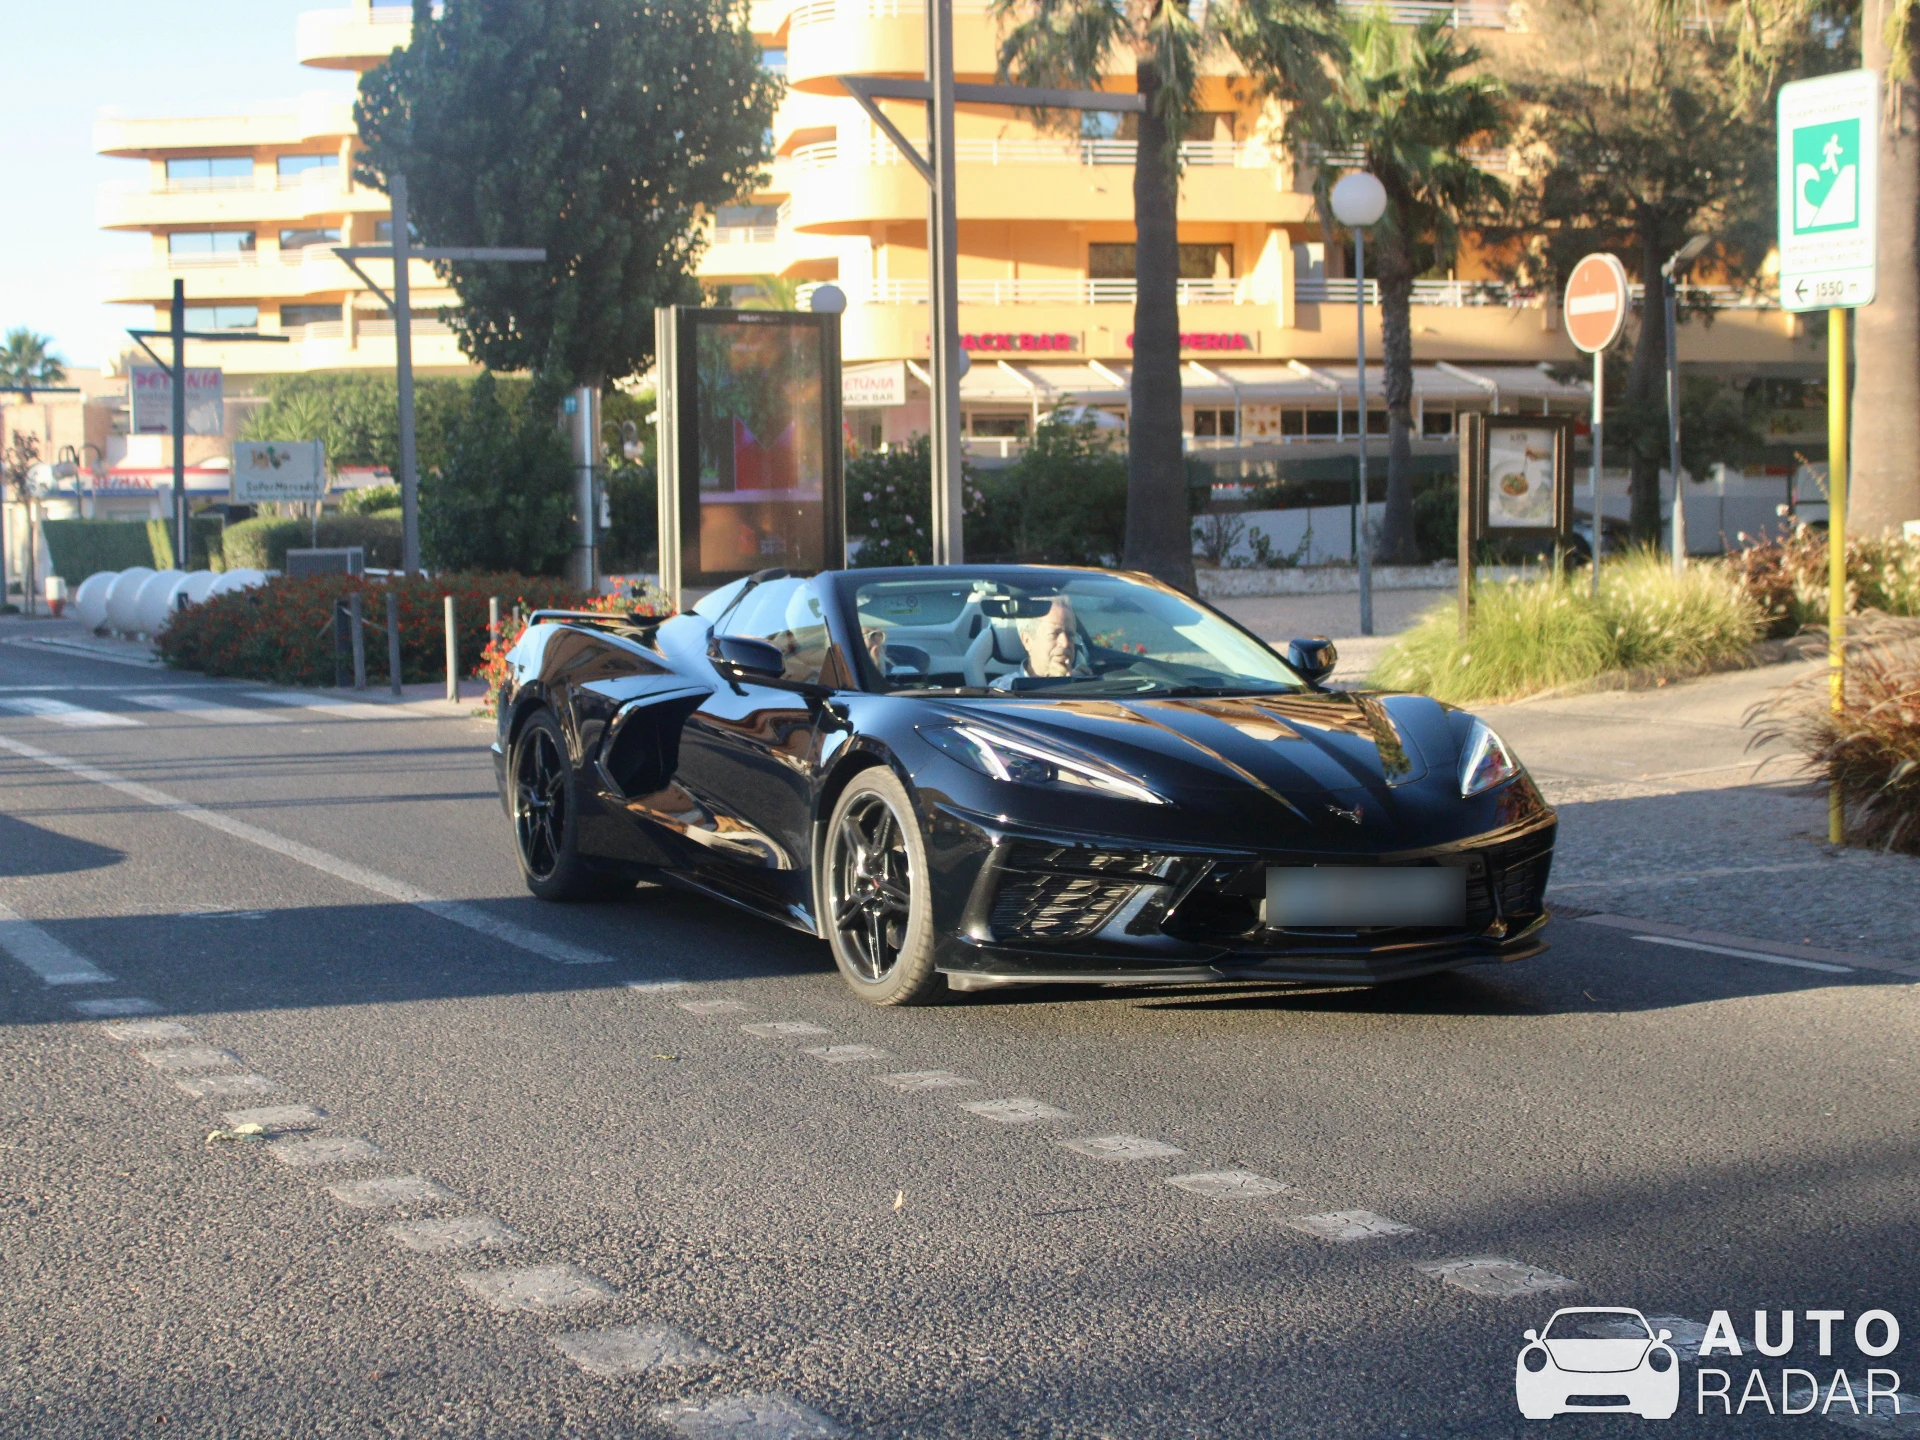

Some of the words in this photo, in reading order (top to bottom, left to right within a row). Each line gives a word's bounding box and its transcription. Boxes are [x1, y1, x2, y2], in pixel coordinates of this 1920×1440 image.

[1815, 280, 1844, 297] 1550
[1019, 333, 1071, 351] BAR
[135, 370, 219, 389] PETNIA
[843, 375, 895, 391] ETÚNIA
[842, 393, 869, 402] NACK
[872, 392, 893, 401] BAR
